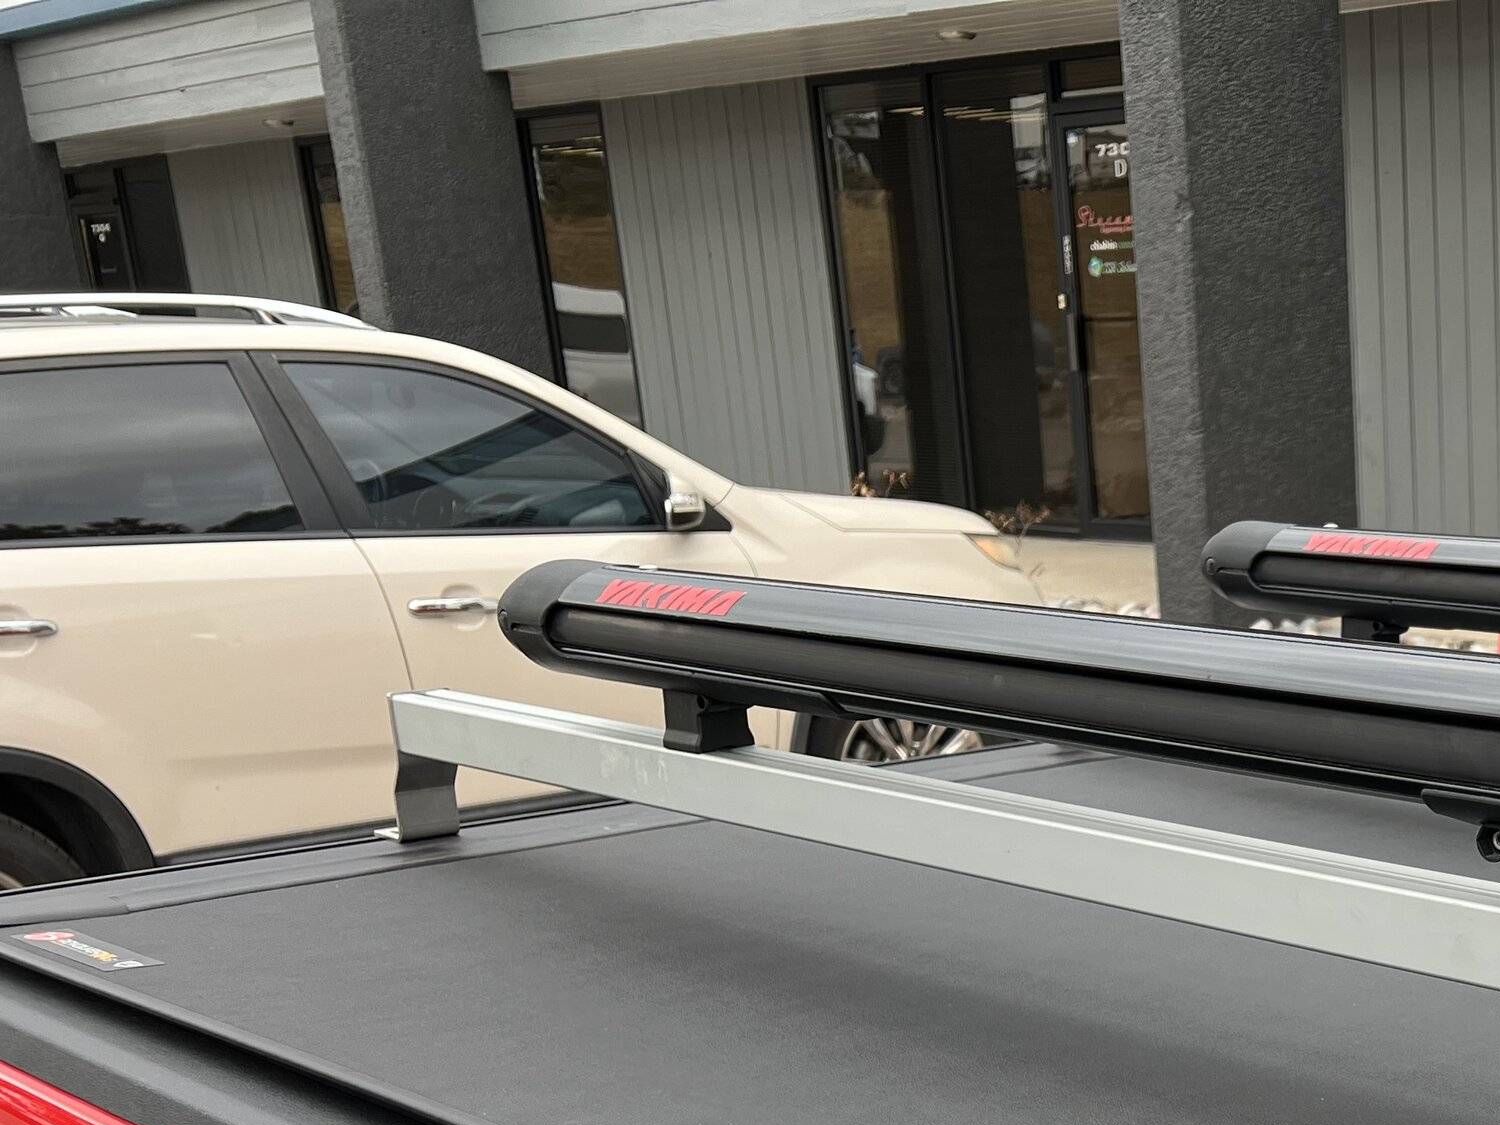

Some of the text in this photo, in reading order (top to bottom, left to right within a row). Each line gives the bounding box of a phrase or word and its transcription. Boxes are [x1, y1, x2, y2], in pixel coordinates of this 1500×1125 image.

[1114, 159, 1128, 178] D
[1304, 533, 1440, 560] YAKIMA
[596, 578, 748, 616] YAKIMA
